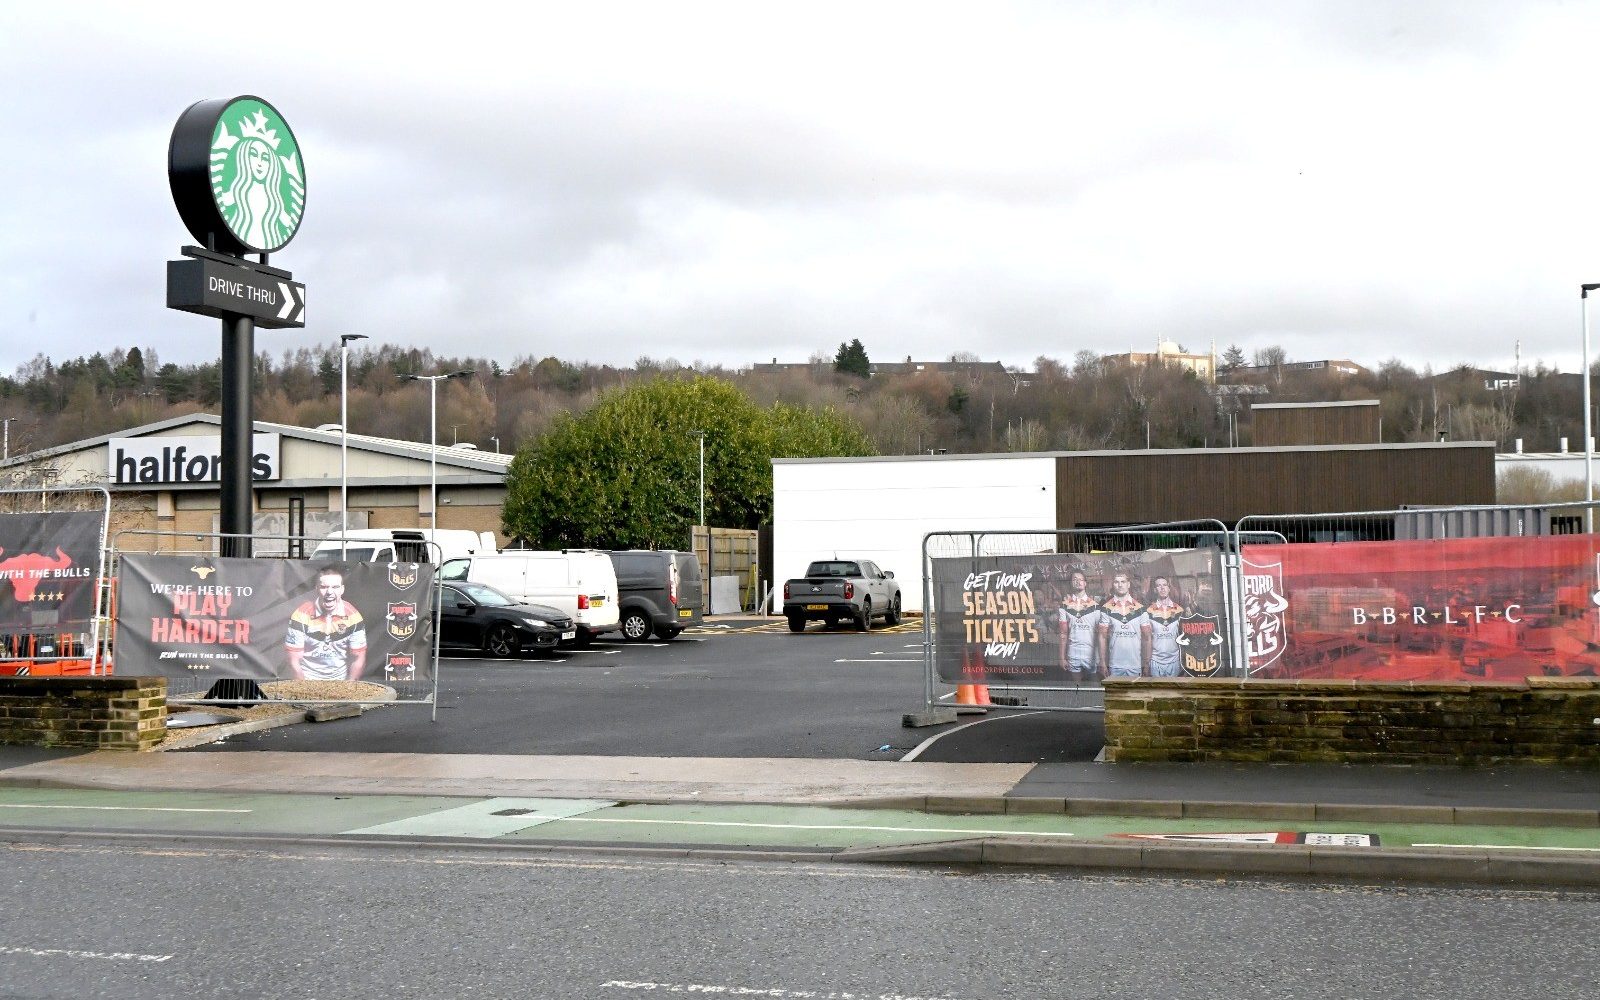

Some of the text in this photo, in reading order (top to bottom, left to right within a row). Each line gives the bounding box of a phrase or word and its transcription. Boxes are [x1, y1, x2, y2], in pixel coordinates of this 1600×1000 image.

[209, 276, 276, 305] DRIVE THRU
[116, 446, 272, 483] halfors
[29, 569, 50, 578] THE
[54, 567, 90, 577] BULLS
[963, 571, 1033, 593] GET YOUR
[151, 583, 253, 597] WE'RE HERE TO
[173, 591, 232, 616] PLAY
[963, 591, 1035, 615] SEASON
[151, 617, 250, 643] HARDER
[963, 618, 1039, 643] TICKETS
[160, 651, 178, 659] RUN
[984, 641, 1020, 660] NOW!
[1185, 652, 1217, 672] BULLS
